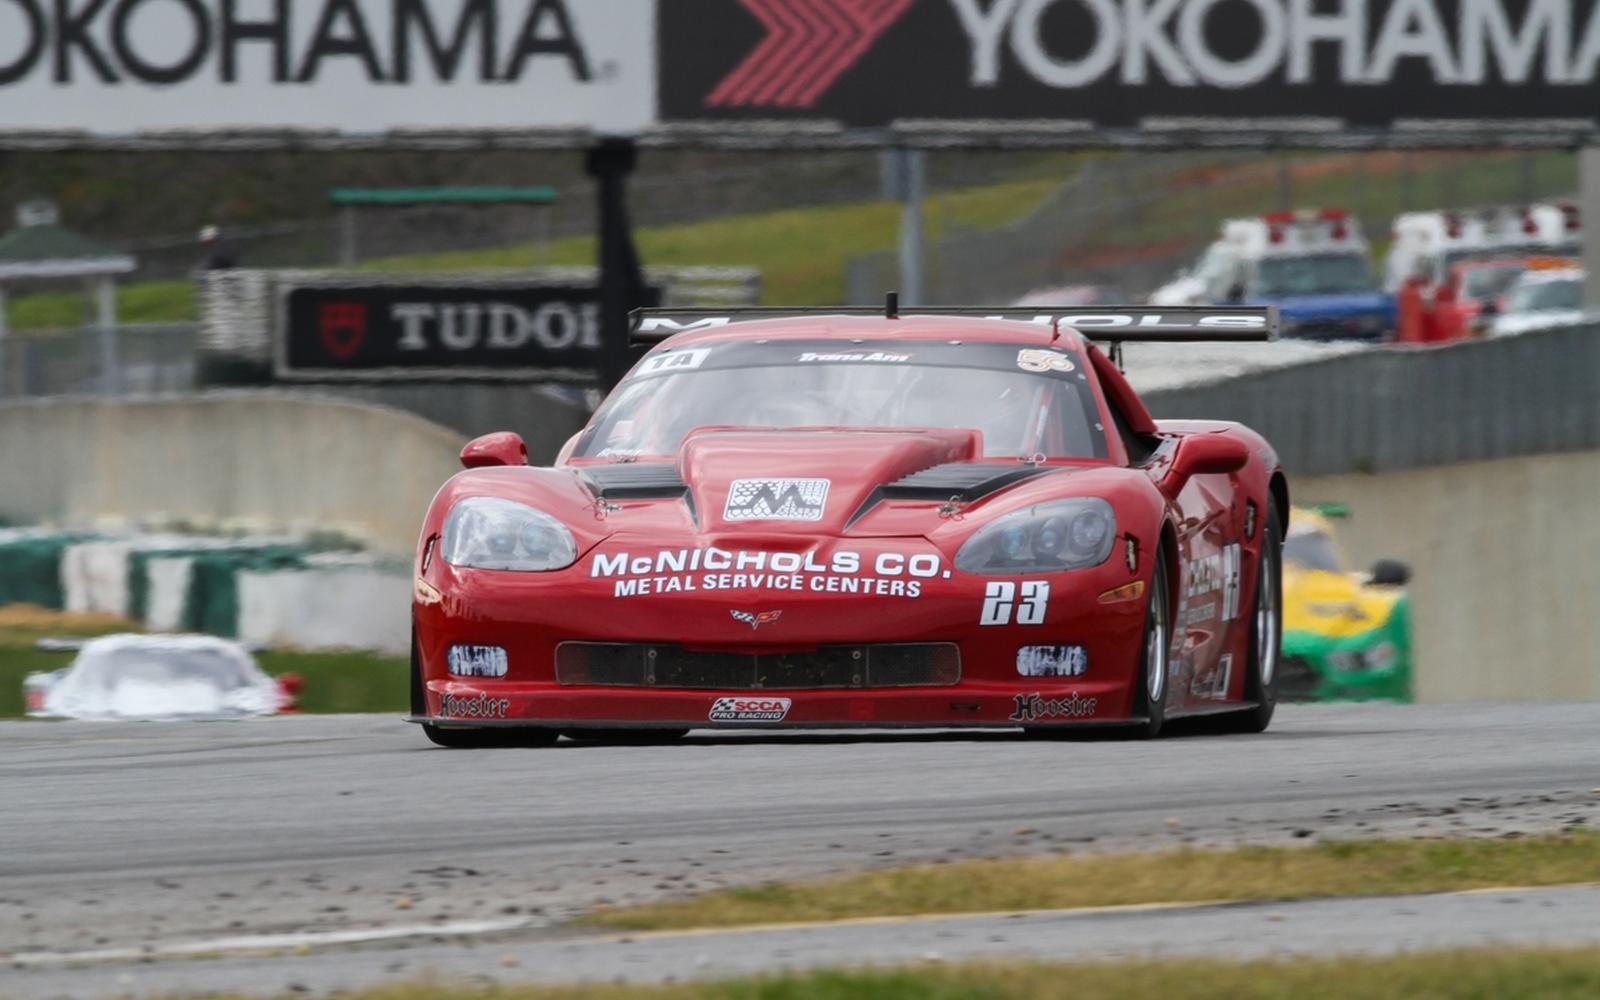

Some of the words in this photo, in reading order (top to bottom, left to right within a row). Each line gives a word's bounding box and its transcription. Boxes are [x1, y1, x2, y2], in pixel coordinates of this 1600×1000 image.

[651, 352, 694, 370] TA
[874, 552, 952, 579] CO.
[613, 576, 696, 598] METAL
[701, 573, 804, 591] SERVICE
[809, 576, 921, 598] CENTERS
[979, 580, 1050, 626] 23
[433, 690, 510, 719] Hoosier
[735, 701, 785, 711] SCCA
[1008, 691, 1097, 721] Hoosier
